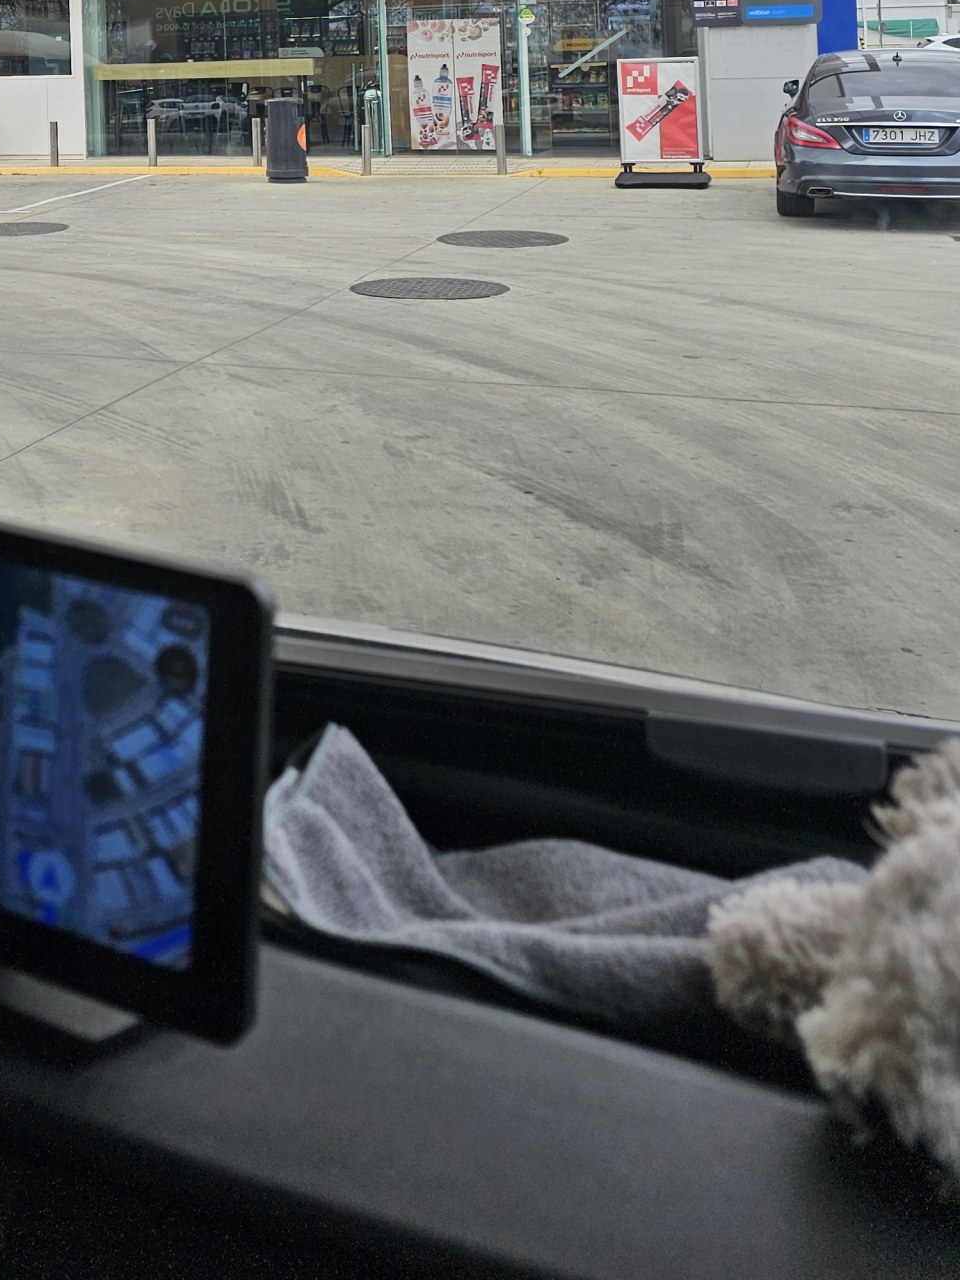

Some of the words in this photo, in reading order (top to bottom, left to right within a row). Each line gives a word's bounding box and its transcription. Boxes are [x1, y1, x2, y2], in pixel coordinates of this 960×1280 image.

[418, 52, 449, 60] nutrisport
[644, 104, 661, 119] Protein
[872, 129, 905, 141] 7301
[910, 130, 936, 142] JHZ
